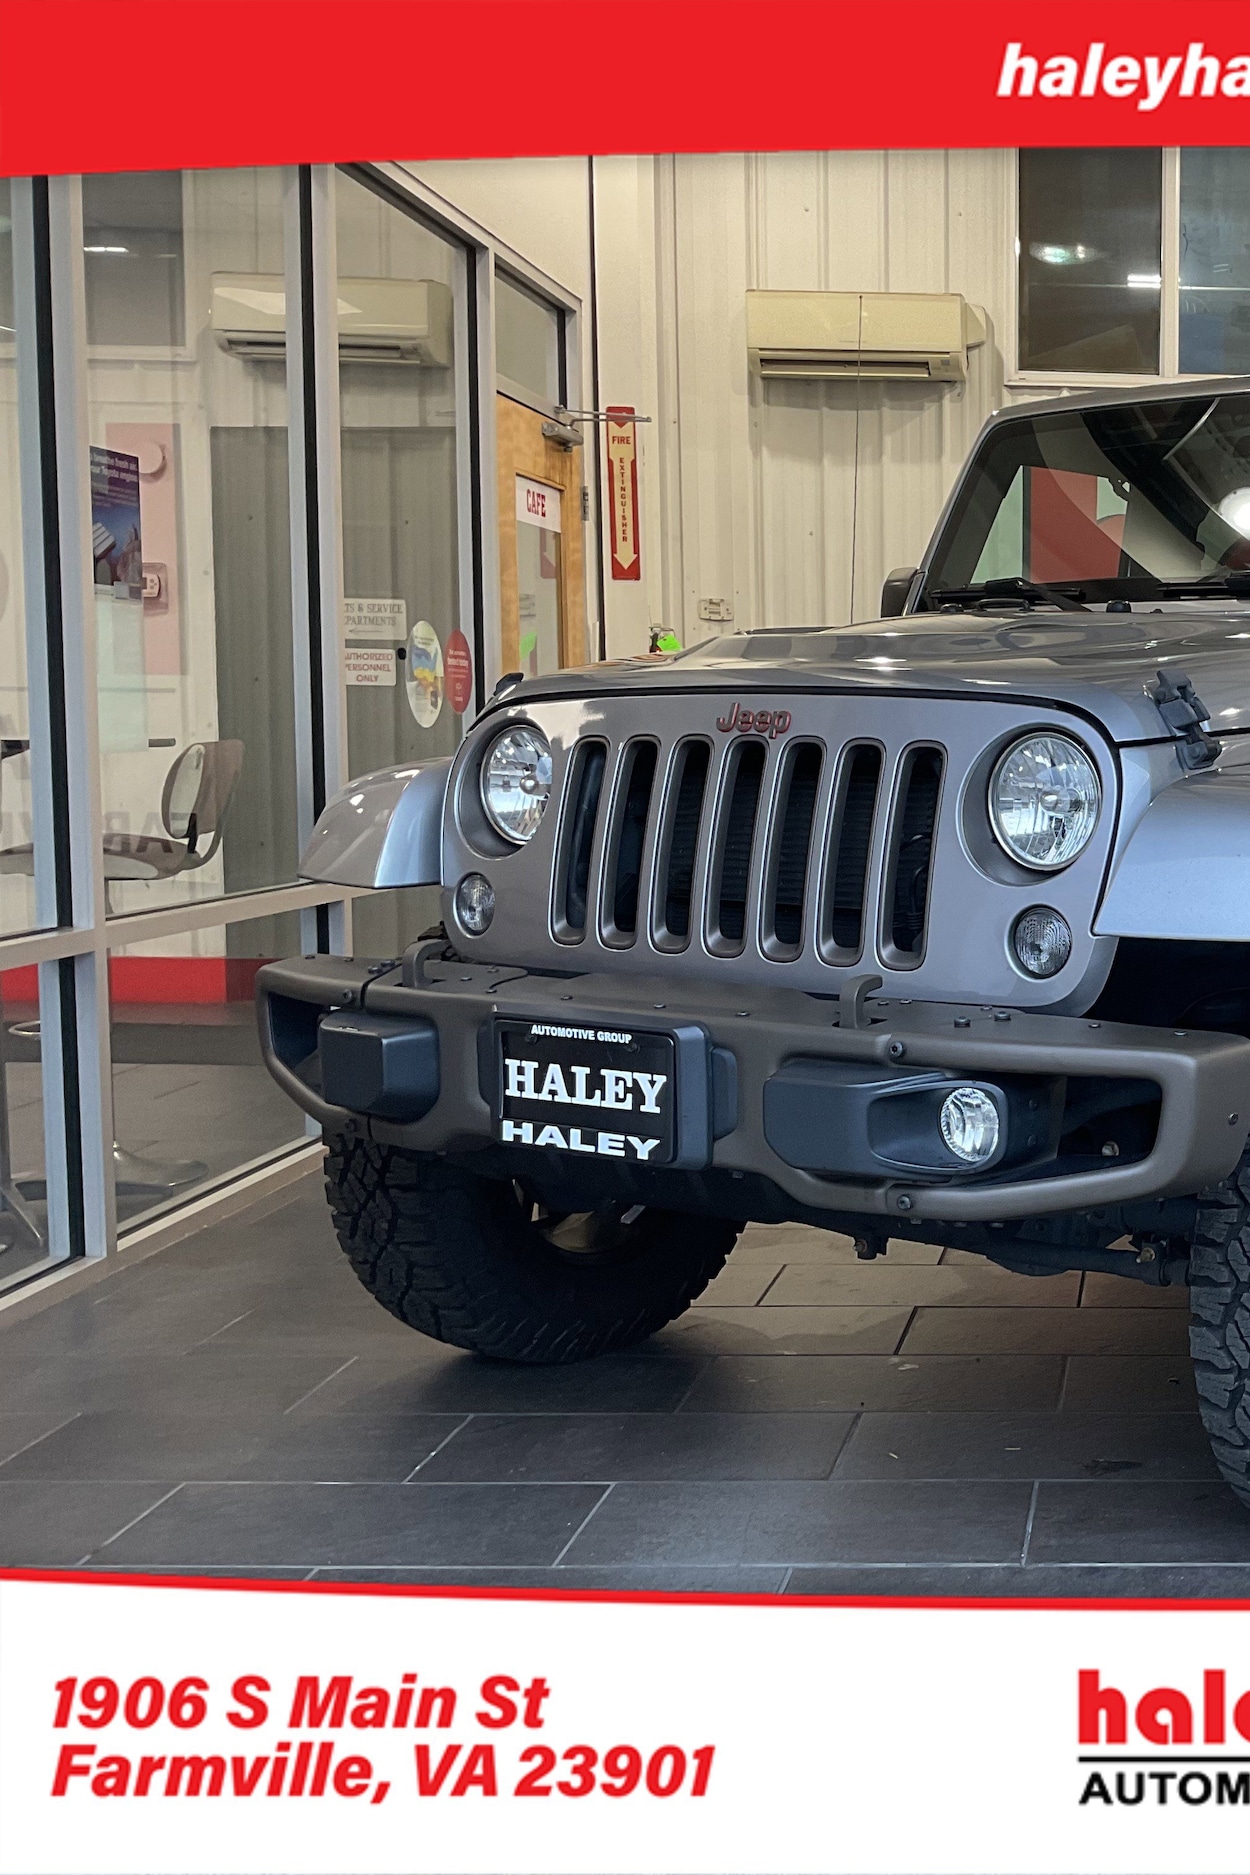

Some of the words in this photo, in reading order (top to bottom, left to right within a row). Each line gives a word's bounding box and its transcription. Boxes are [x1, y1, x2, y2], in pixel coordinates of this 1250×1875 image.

[612, 435, 631, 445] FIRE
[526, 489, 547, 518] CAFE
[619, 457, 629, 543] EXTINGUISHER
[344, 615, 397, 626] PARTMENTS
[366, 603, 403, 614] SERVICE
[356, 674, 379, 683] ONLY
[716, 702, 791, 740] Jeep
[531, 1024, 596, 1041] AUTOMOTIVE
[597, 1031, 632, 1044] GROUP
[505, 1058, 667, 1114] HALEY
[502, 1120, 661, 1161] HALEY
